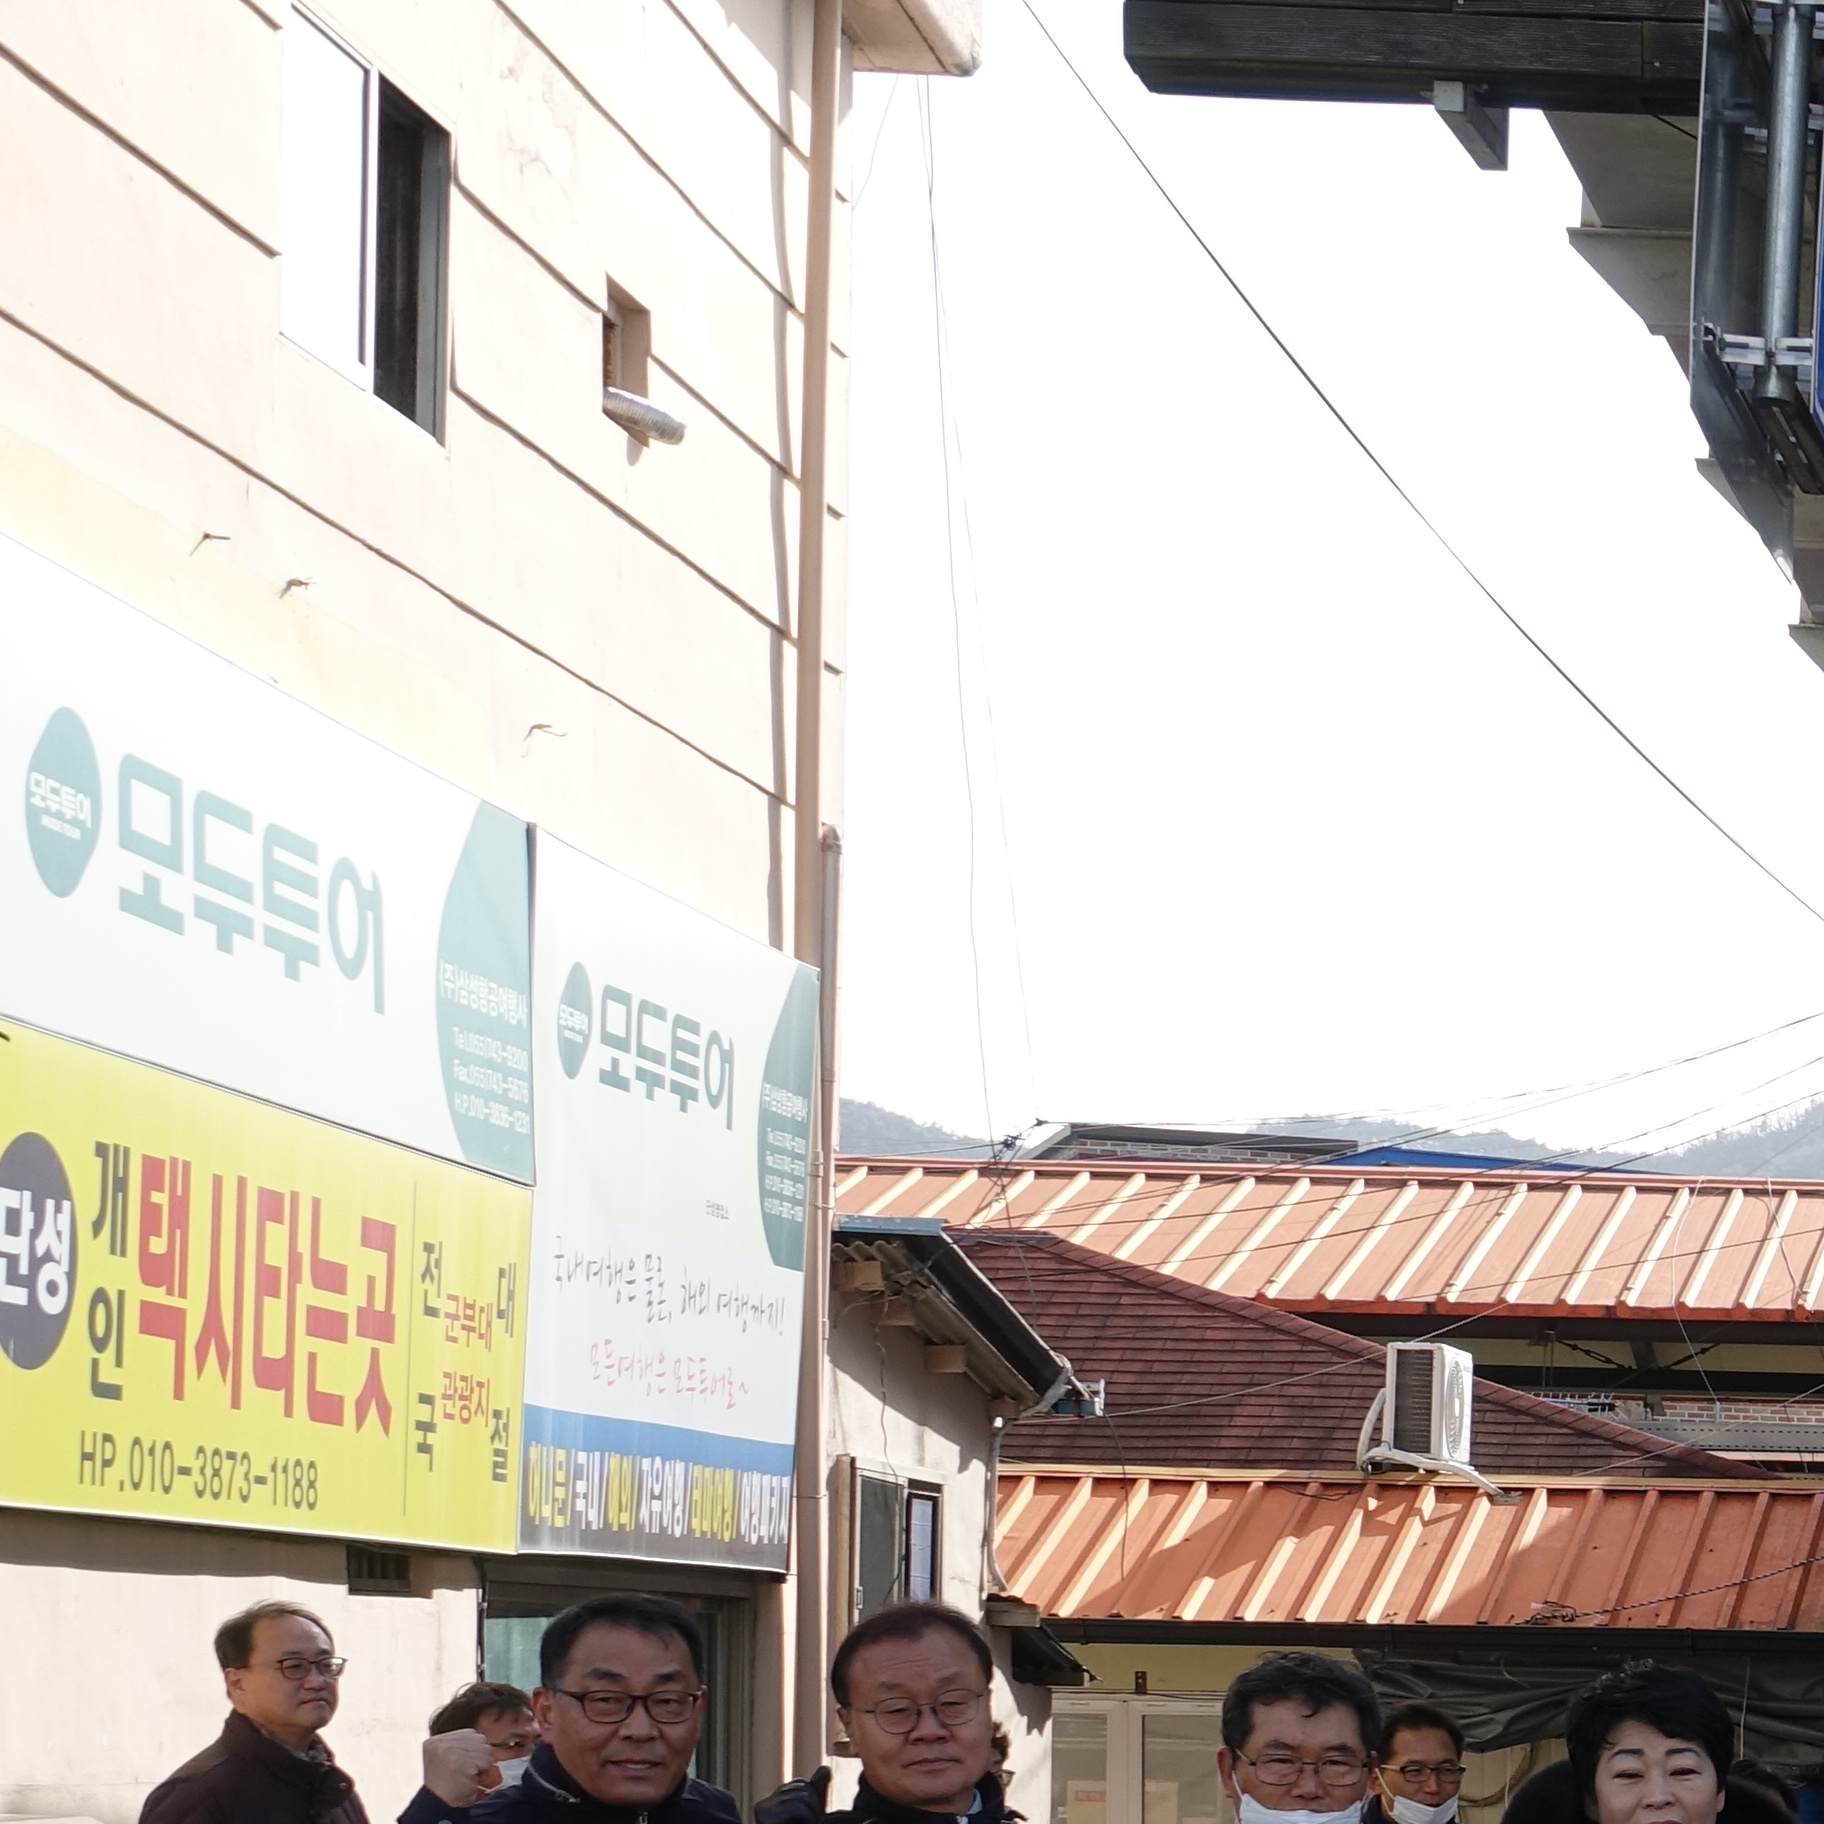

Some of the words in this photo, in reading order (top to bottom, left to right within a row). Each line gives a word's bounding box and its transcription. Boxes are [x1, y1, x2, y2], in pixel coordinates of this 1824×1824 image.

[30, 771, 92, 828] 모두투어
[118, 753, 385, 1016] 모두투어
[440, 958, 528, 1029] (주)삼성항공여행사
[599, 984, 735, 1131] 모두투어
[0, 1187, 72, 1315] 단성
[138, 1153, 397, 1439] 택시타는곳
[553, 1235, 637, 1304] 국내여행은
[680, 1264, 711, 1316] 해외
[717, 1280, 786, 1337] 여행까지!
[444, 1292, 494, 1352] 군부대
[441, 1371, 491, 1428] 관광지
[79, 1429, 319, 1511] HP.010-3873-1188
